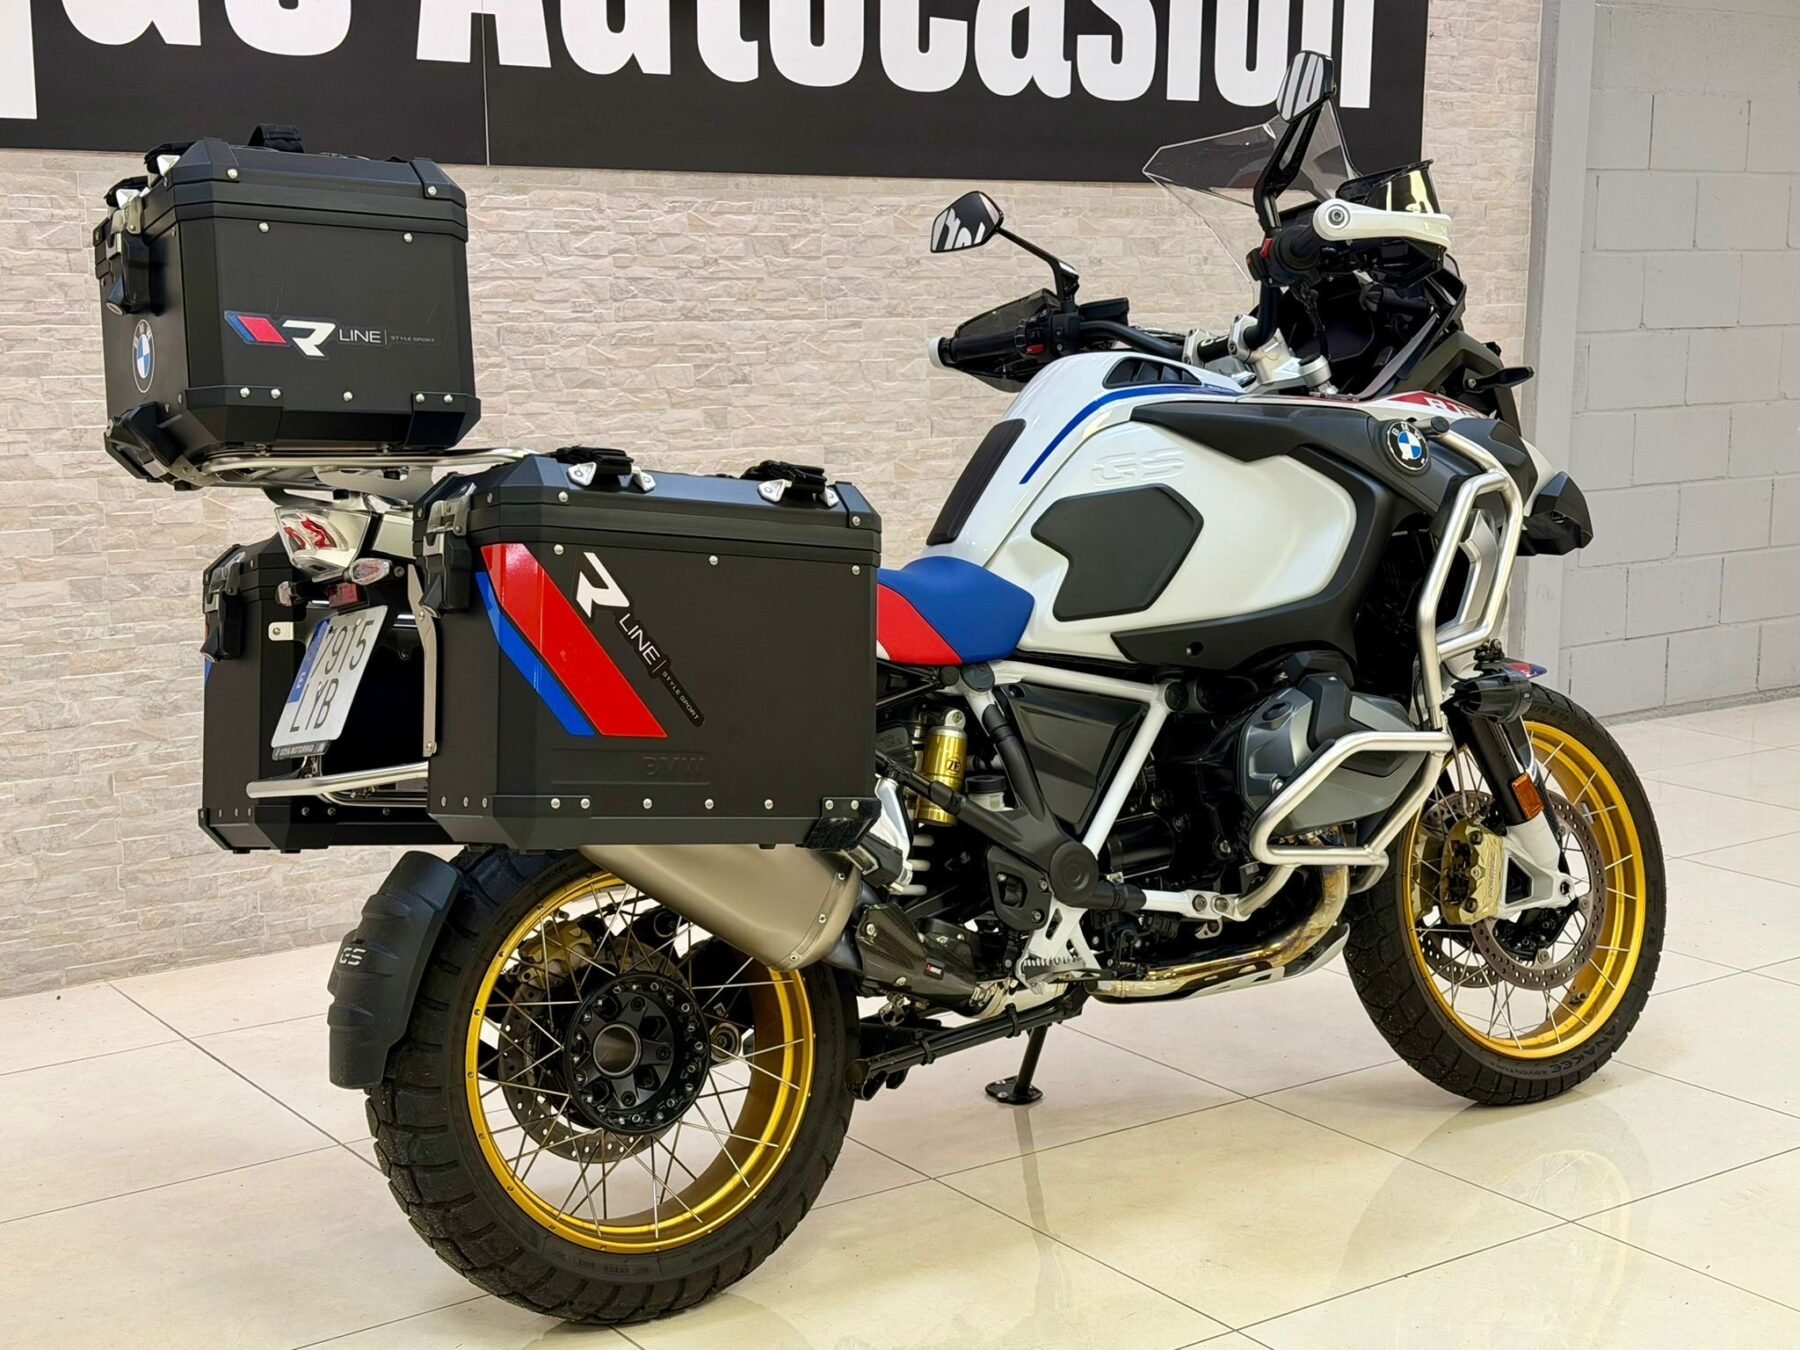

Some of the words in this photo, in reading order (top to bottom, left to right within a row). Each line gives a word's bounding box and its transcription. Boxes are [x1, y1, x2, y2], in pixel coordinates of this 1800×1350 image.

[281, 319, 336, 357] R
[339, 329, 382, 343] LINE
[1089, 447, 1186, 487] GS
[310, 619, 375, 679] 7915
[618, 613, 661, 666] LINE
[661, 670, 682, 696] STYLE
[679, 694, 700, 720] SPORT
[289, 678, 340, 733] LYB
[642, 755, 704, 778] BMW
[339, 947, 367, 966] GS
[1550, 1025, 1617, 1073] ANAKEE
